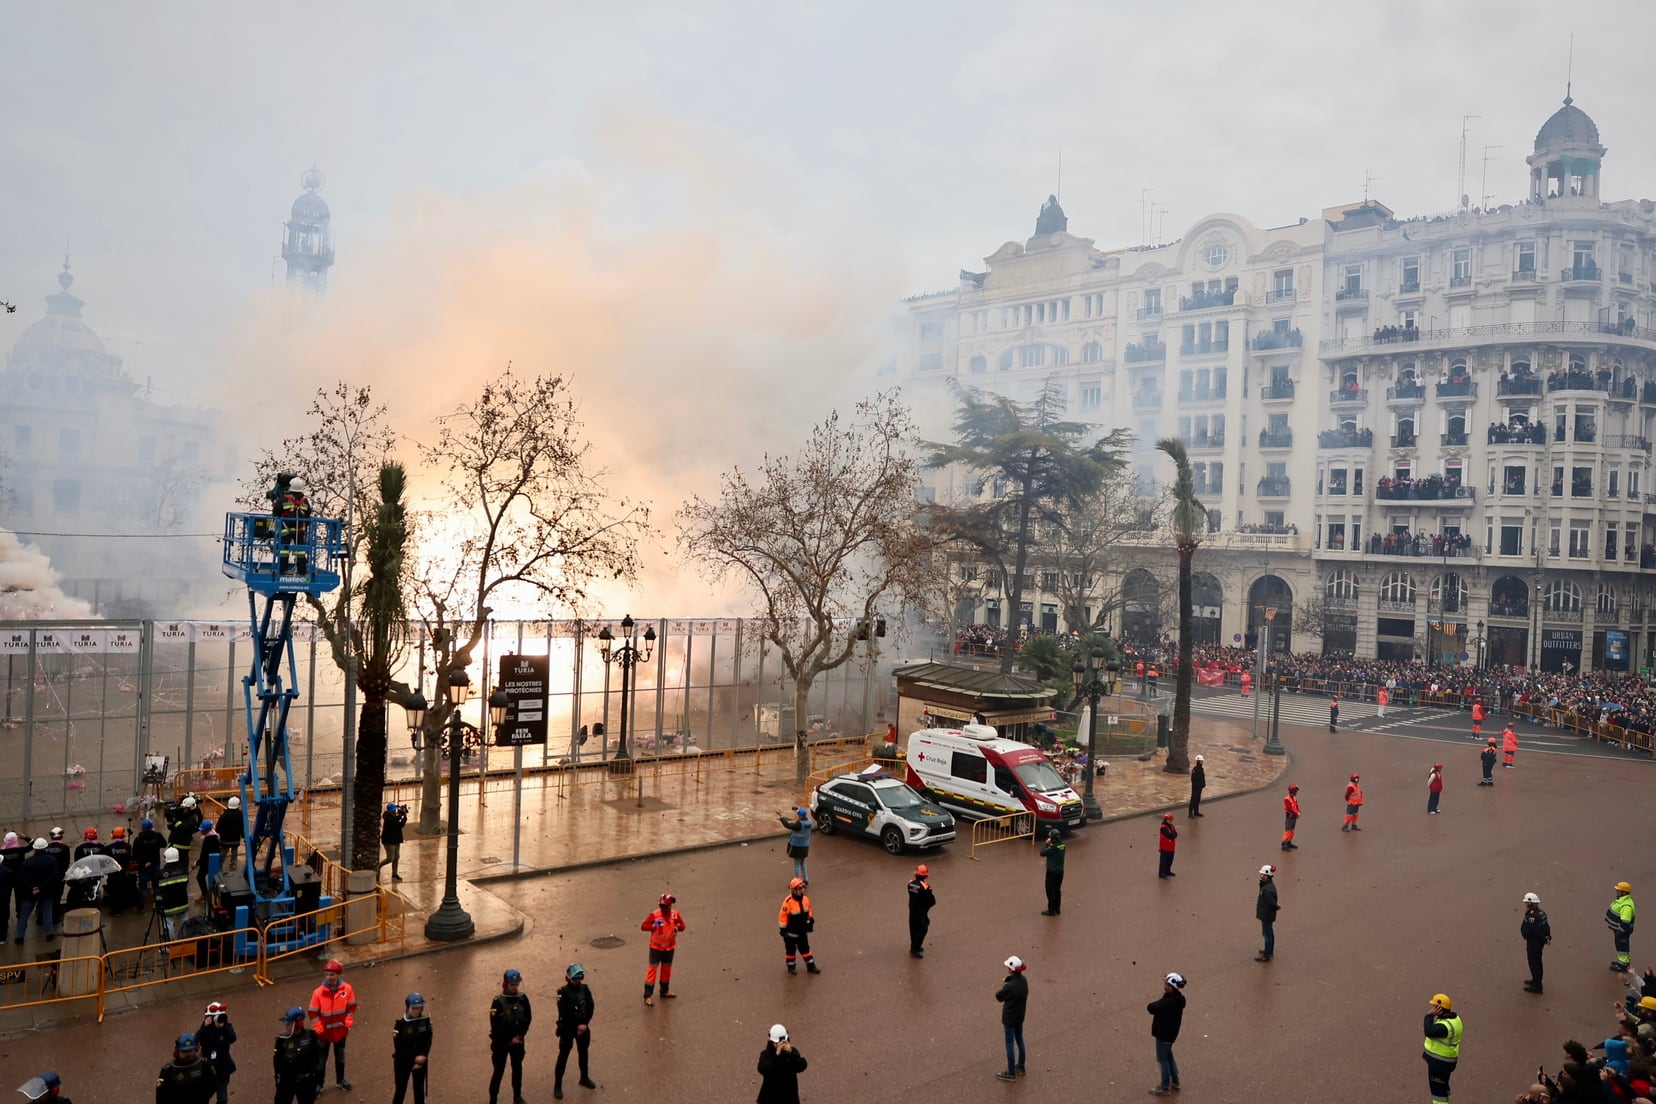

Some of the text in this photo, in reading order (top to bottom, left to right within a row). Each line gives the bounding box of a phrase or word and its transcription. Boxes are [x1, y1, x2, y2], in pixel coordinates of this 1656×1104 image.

[1551, 631, 1574, 640] URBAN
[1543, 640, 1582, 650] OUTFITTERS
[926, 755, 947, 766] Cruz Roja
[833, 805, 863, 819] GUARDIA CIVIL
